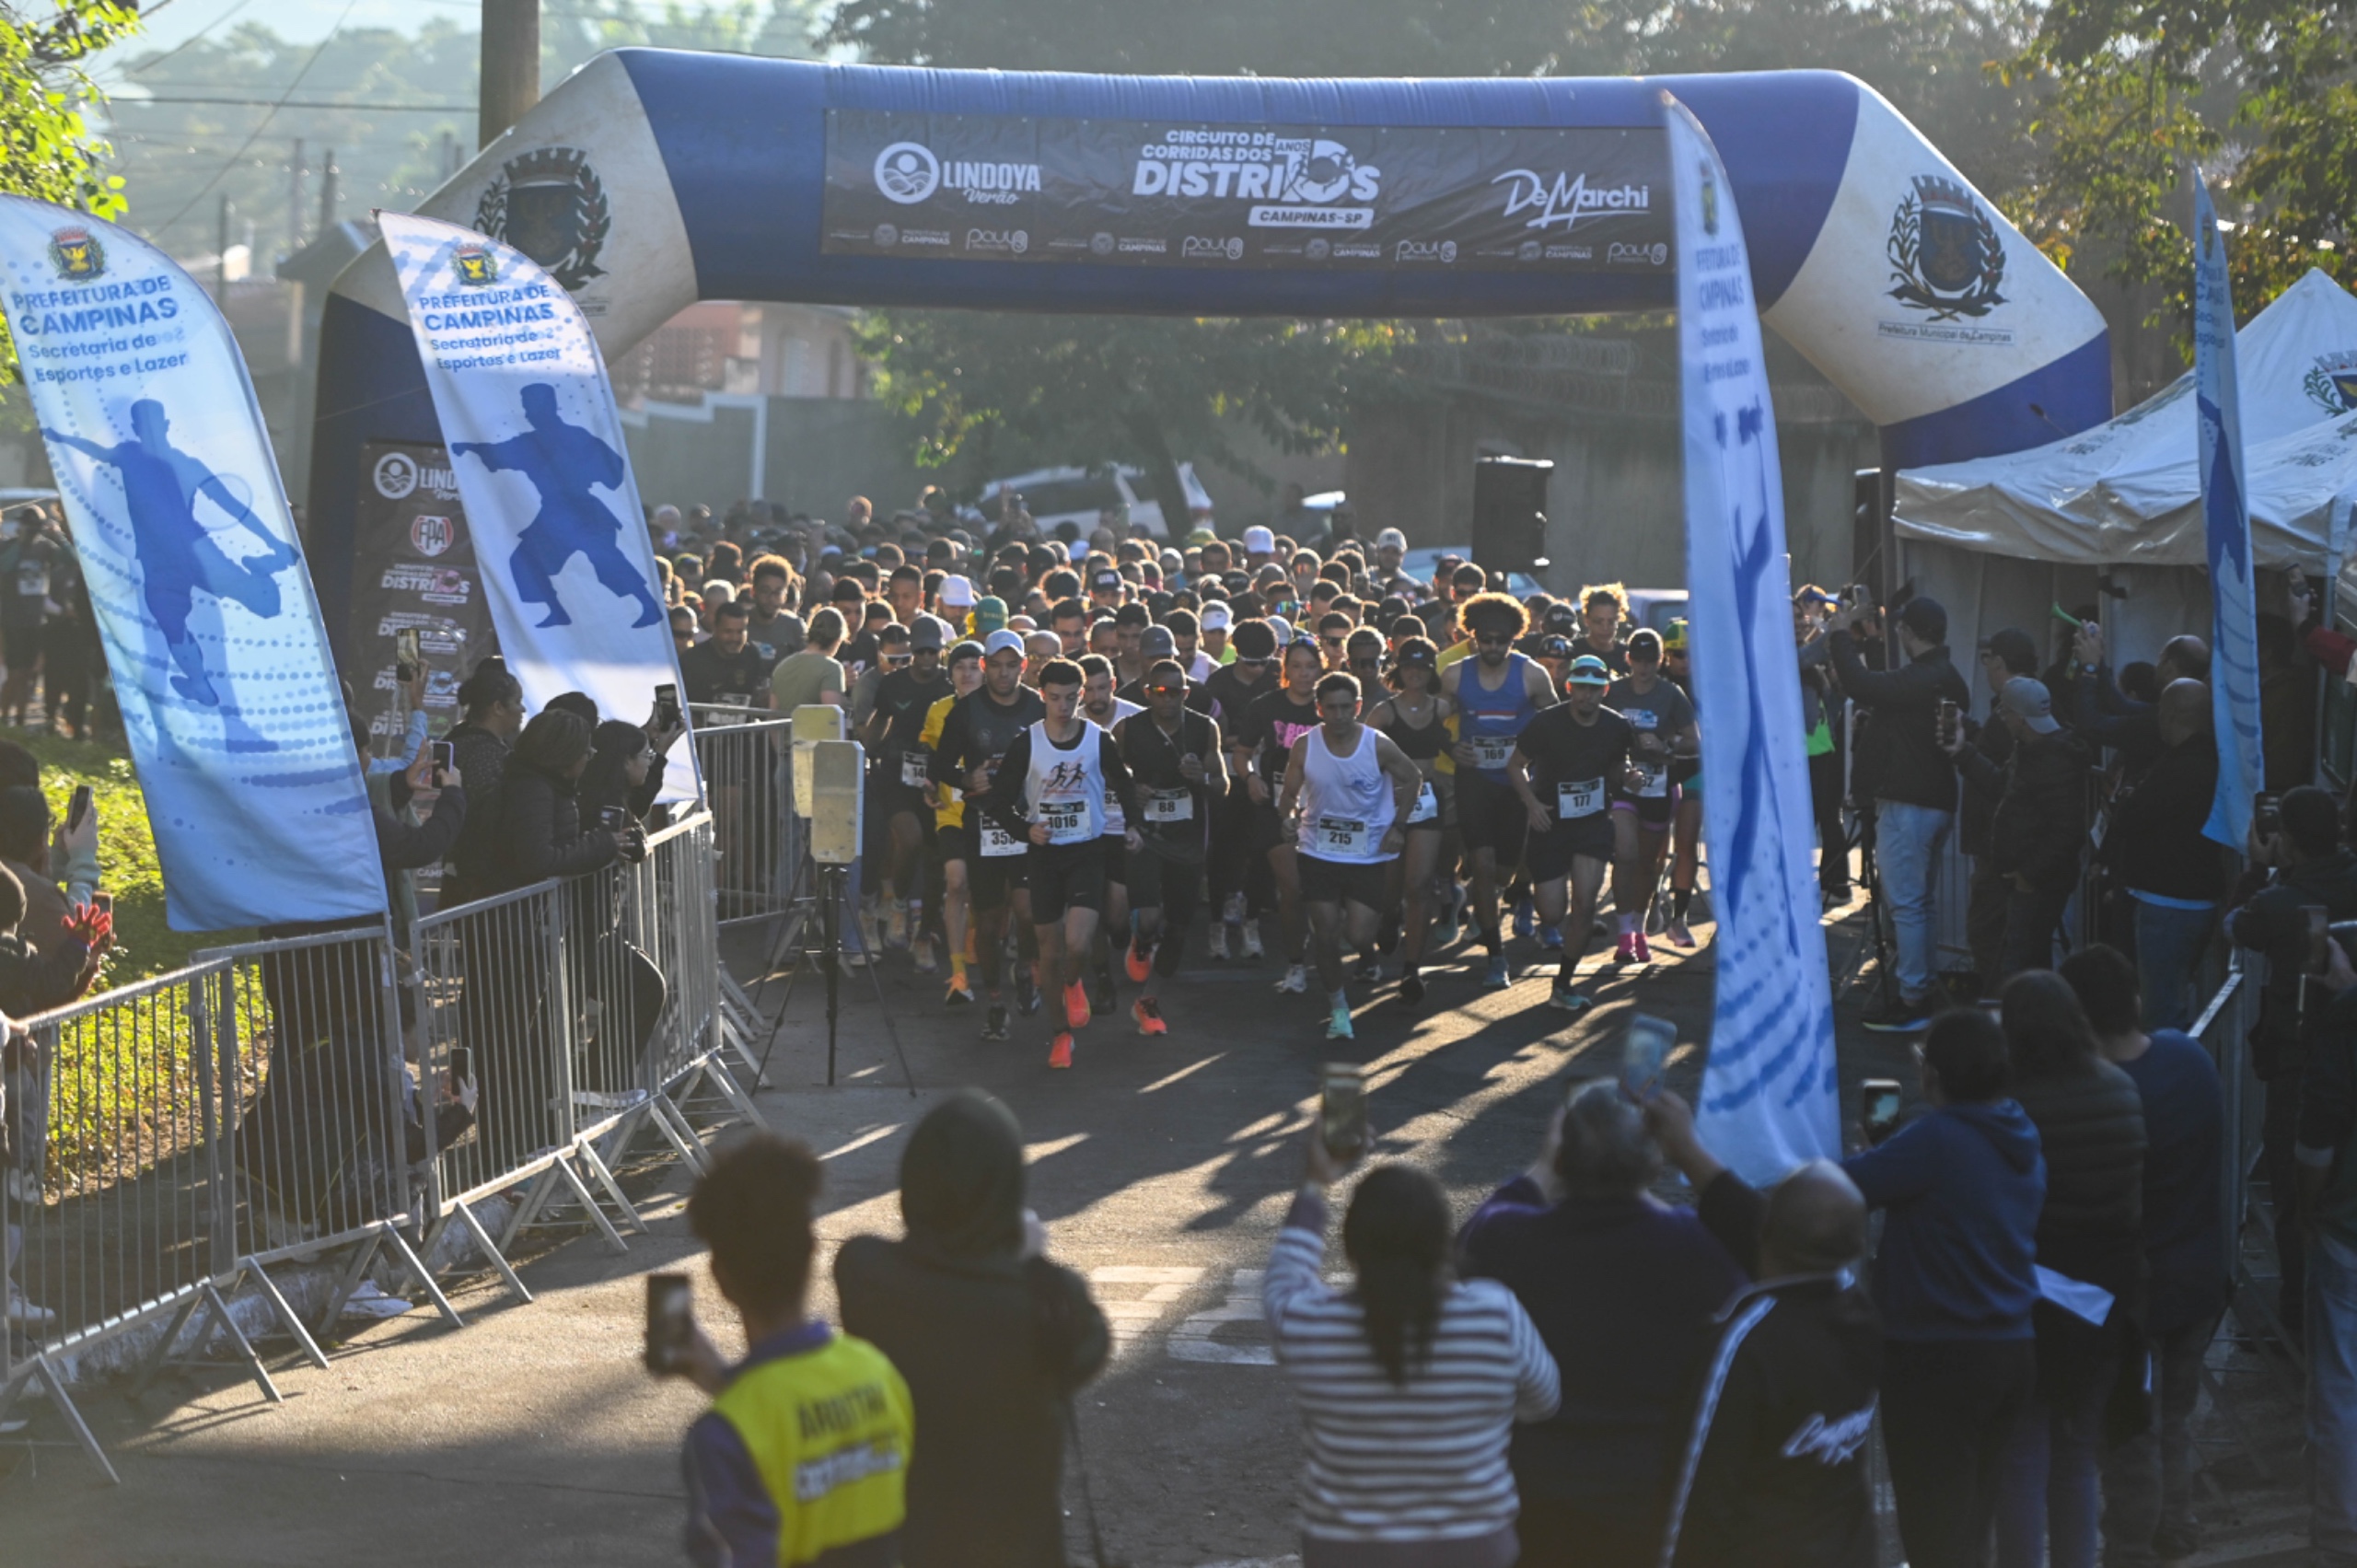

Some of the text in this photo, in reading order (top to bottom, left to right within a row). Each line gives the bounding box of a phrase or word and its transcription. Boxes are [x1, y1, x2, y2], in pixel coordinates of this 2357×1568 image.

[1167, 130, 1275, 145] CIRCUITO DE
[1276, 141, 1310, 152] ANOS
[1143, 145, 1271, 161] CORRIDAS DOS
[943, 160, 1041, 192] LINDOYA
[963, 187, 1019, 204] Verão
[902, 235, 950, 245] CAMPINAS
[1119, 243, 1167, 252] CAMPINAS
[11, 275, 171, 309] PREFEITURA DE
[419, 285, 551, 309] PREFEITURA DE
[20, 297, 179, 335] CAMPINAS
[424, 302, 554, 331] CAMPINAS
[29, 333, 157, 358] Secretaria de
[431, 331, 538, 350] Secretaria de
[35, 353, 187, 385] Esportes e Lazer
[436, 348, 561, 373] Esportes e Lazer
[419, 469, 458, 490] LIND
[419, 518, 447, 550] FPA
[1484, 749, 1504, 760] 169
[1158, 801, 1175, 812] 88
[1573, 794, 1590, 807] 177
[1048, 815, 1077, 829] 1016
[1329, 831, 1352, 845] 215
